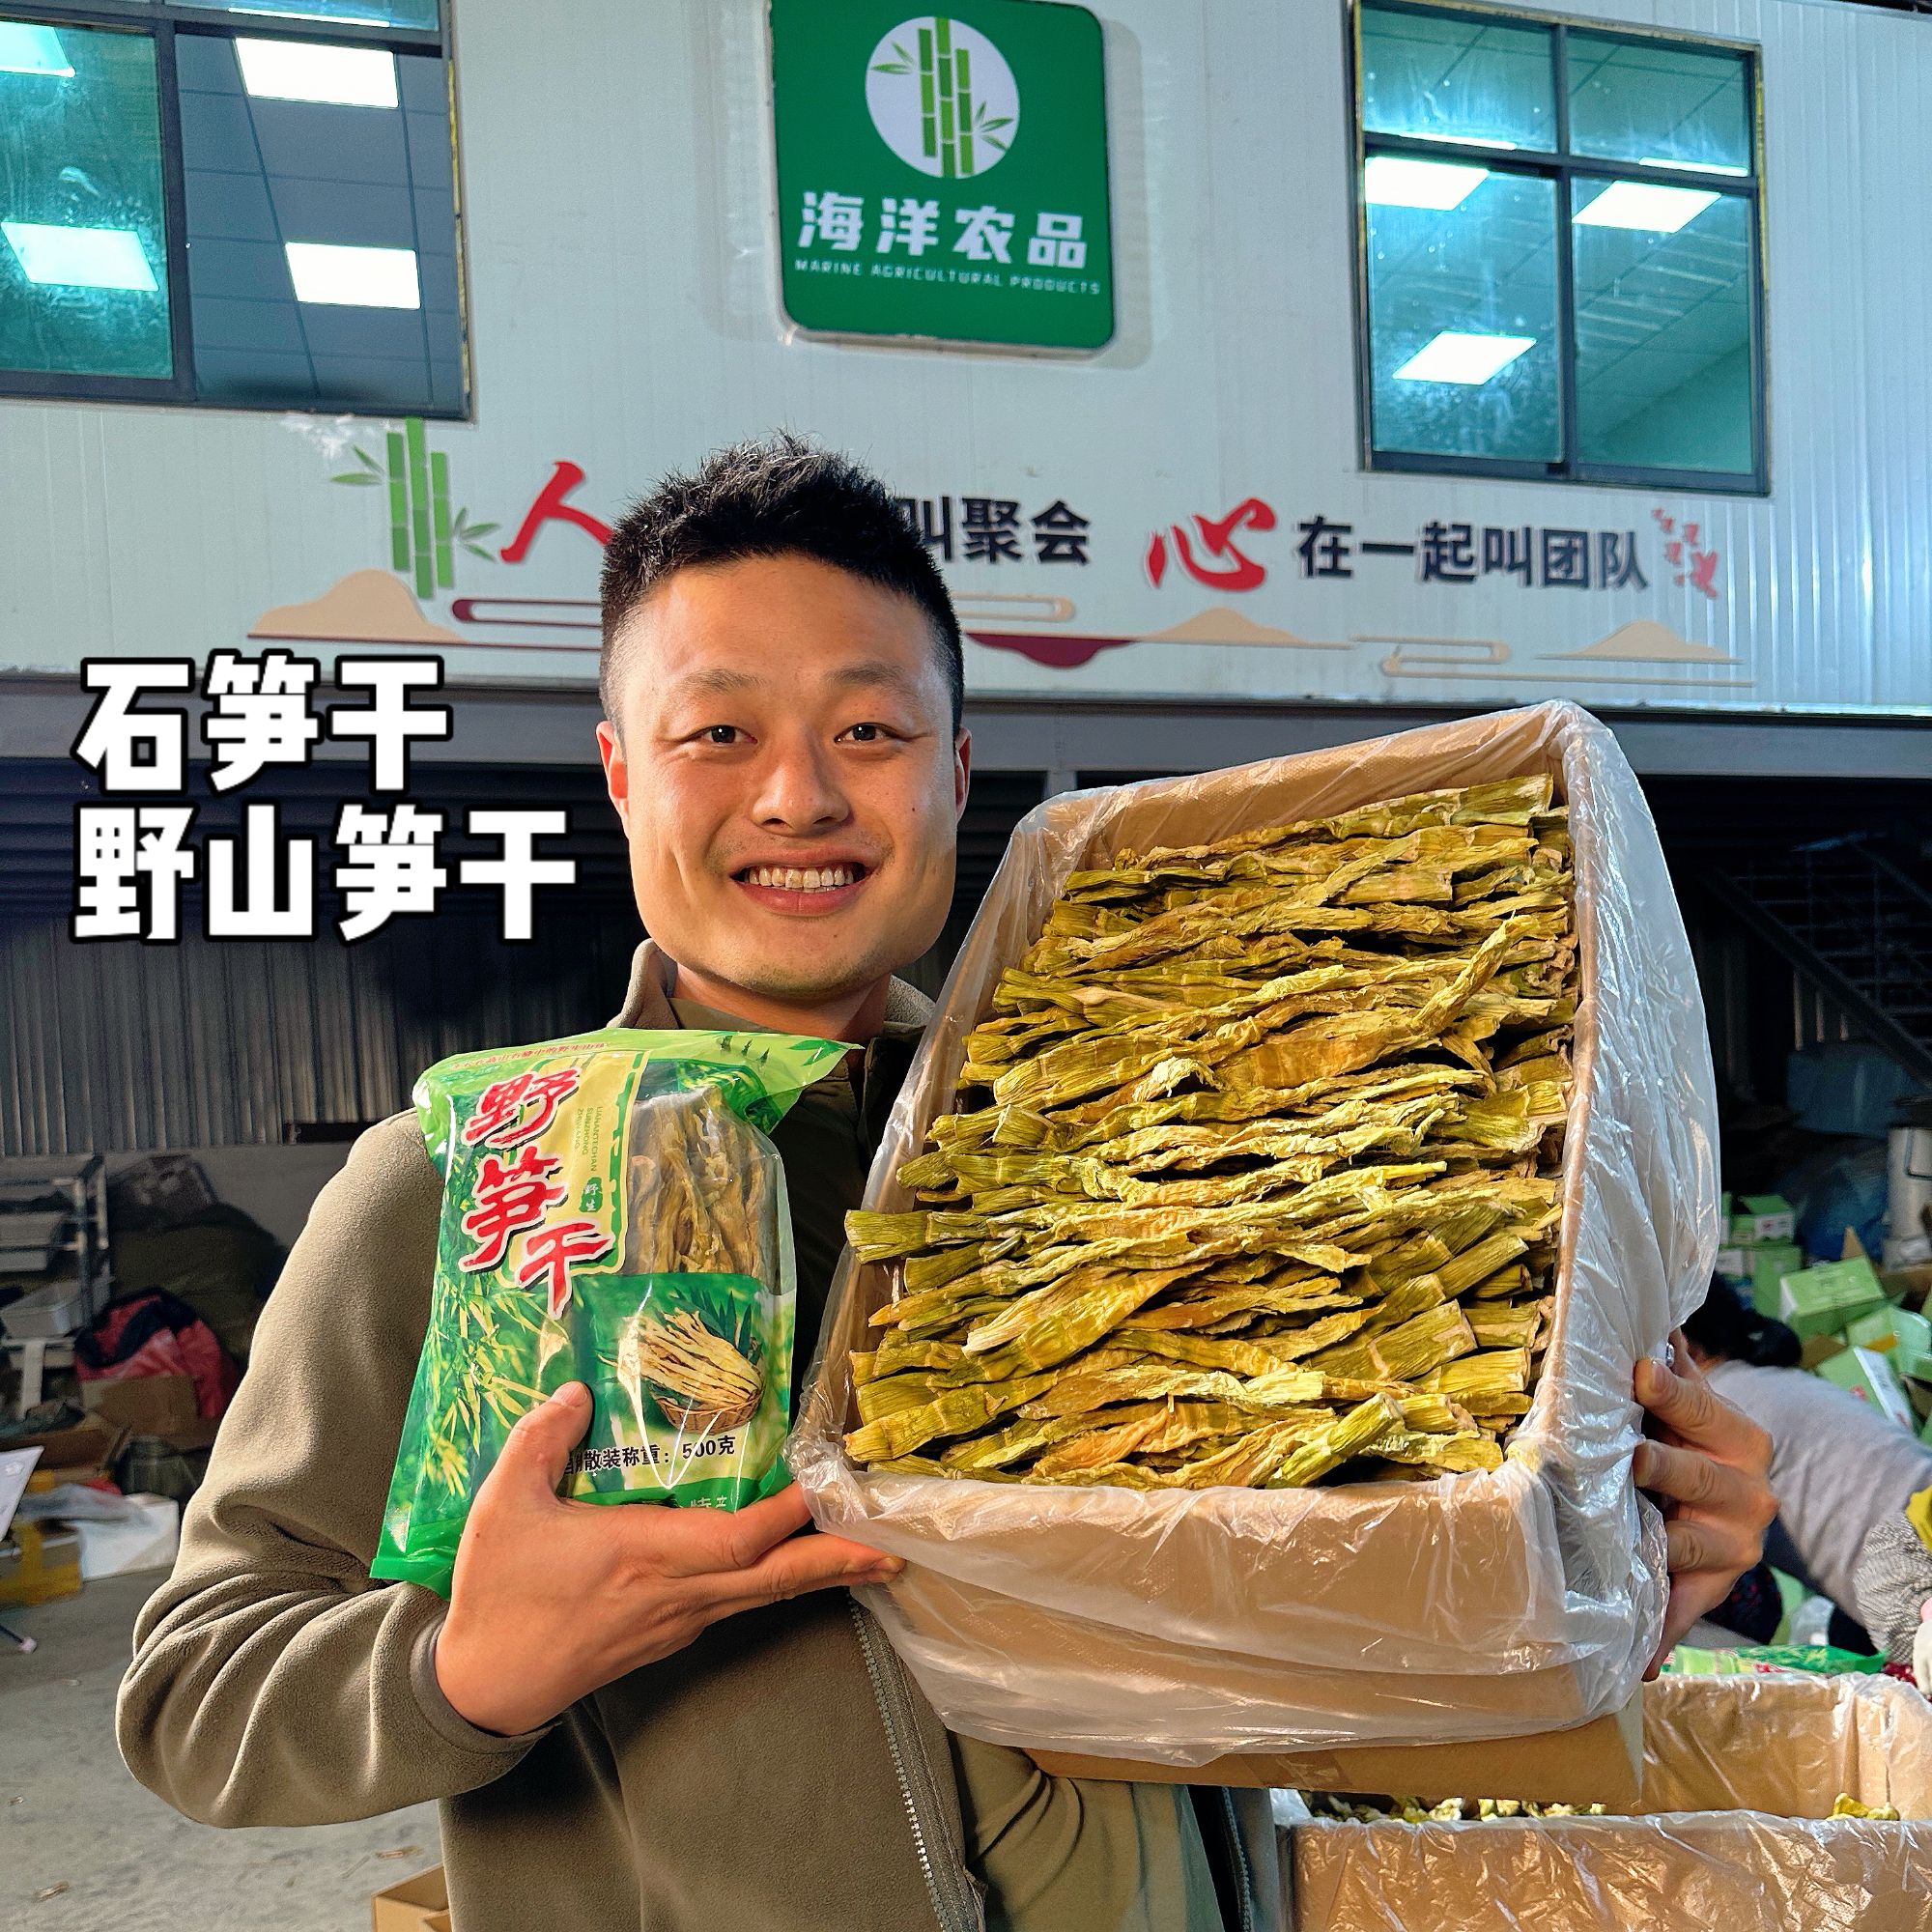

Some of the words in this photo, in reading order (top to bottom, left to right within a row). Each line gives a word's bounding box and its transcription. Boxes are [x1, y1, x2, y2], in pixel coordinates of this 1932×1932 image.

[794, 259, 863, 276] MARINE
[870, 264, 1004, 288] AGRICULTURAL
[1009, 276, 1101, 296] PRODUCTS
[798, 190, 1088, 270] 海洋农品
[499, 460, 611, 564] 人
[1146, 497, 1650, 593] 心在一起叫团队
[458, 1065, 614, 1320] 野笋干
